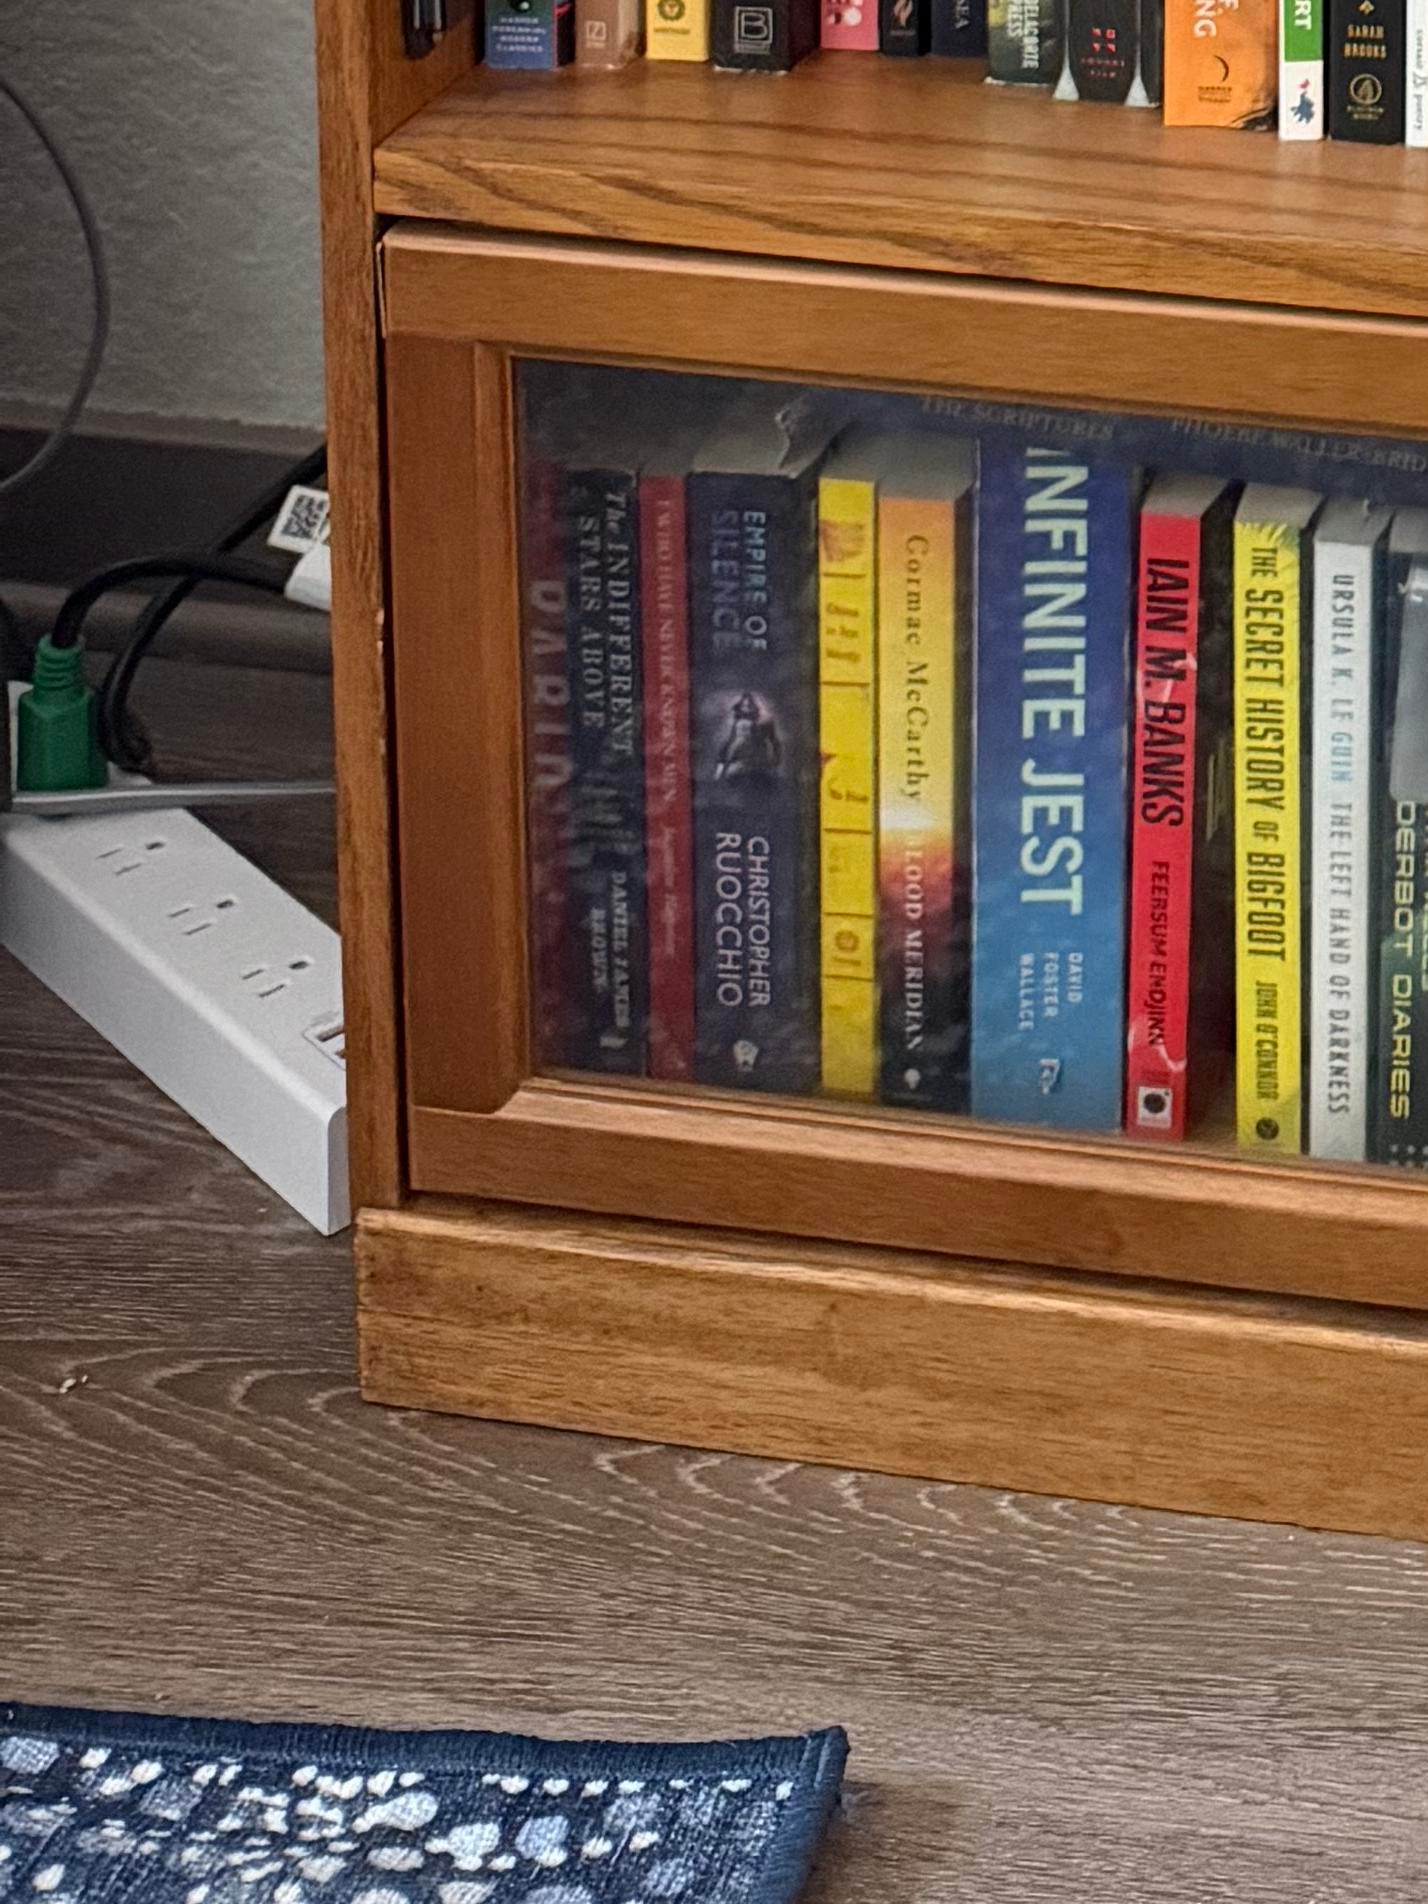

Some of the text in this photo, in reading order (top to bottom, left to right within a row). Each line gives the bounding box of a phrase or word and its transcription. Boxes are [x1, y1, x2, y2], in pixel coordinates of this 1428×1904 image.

[1018, 448, 1087, 914] NFINITE JEST
[1141, 561, 1189, 826] IAIN M. BANKS
